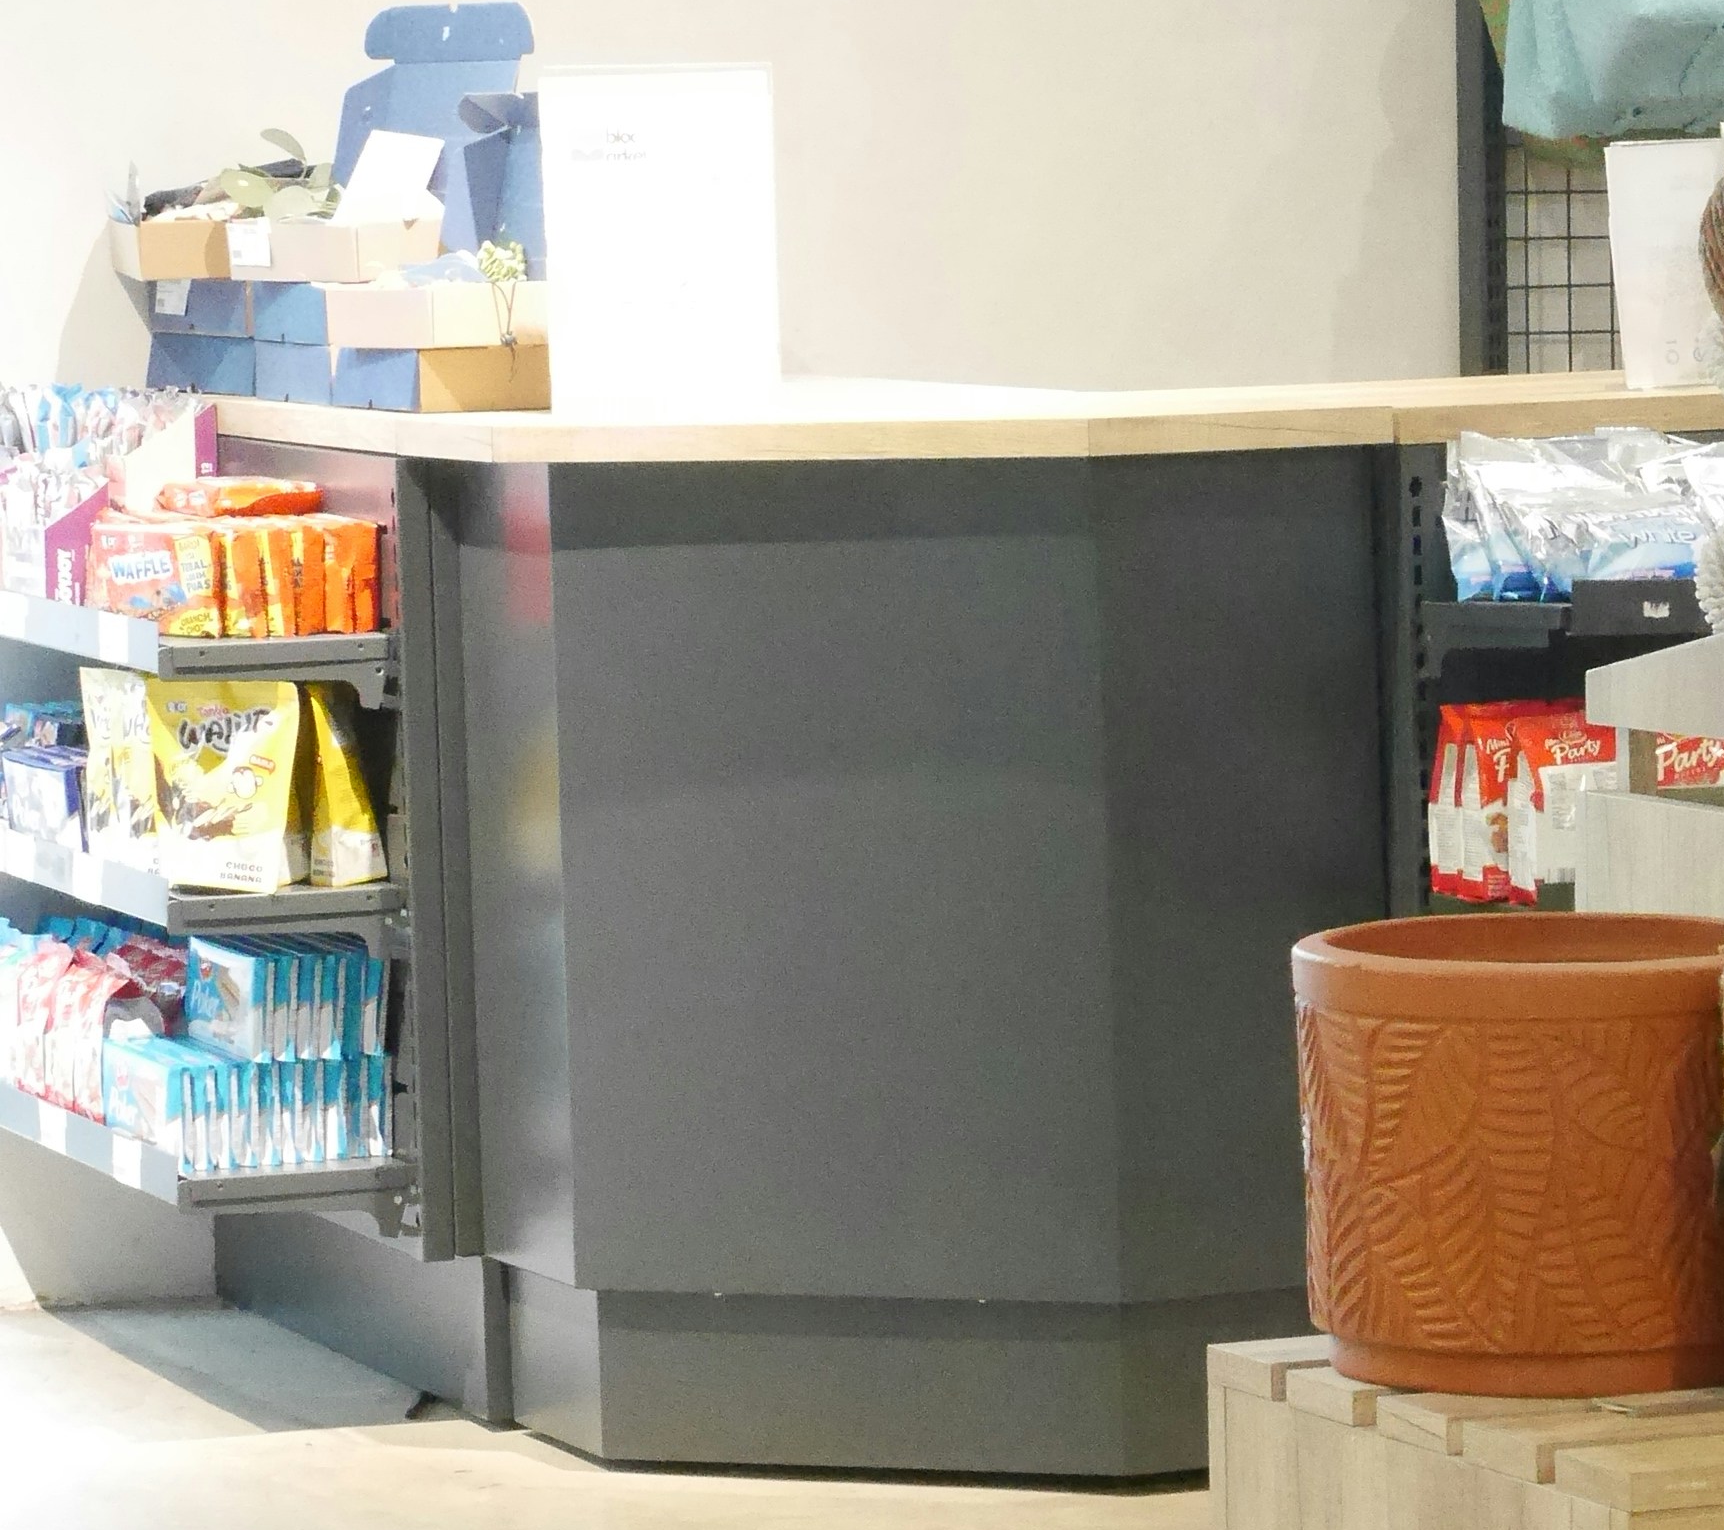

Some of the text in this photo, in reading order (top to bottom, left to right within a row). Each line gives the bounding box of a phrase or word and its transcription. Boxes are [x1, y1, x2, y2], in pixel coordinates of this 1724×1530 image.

[111, 556, 171, 580] WAFFLE
[1550, 738, 1601, 765] Party
[225, 860, 263, 873] CHOCO
[219, 871, 262, 884] BANANA
